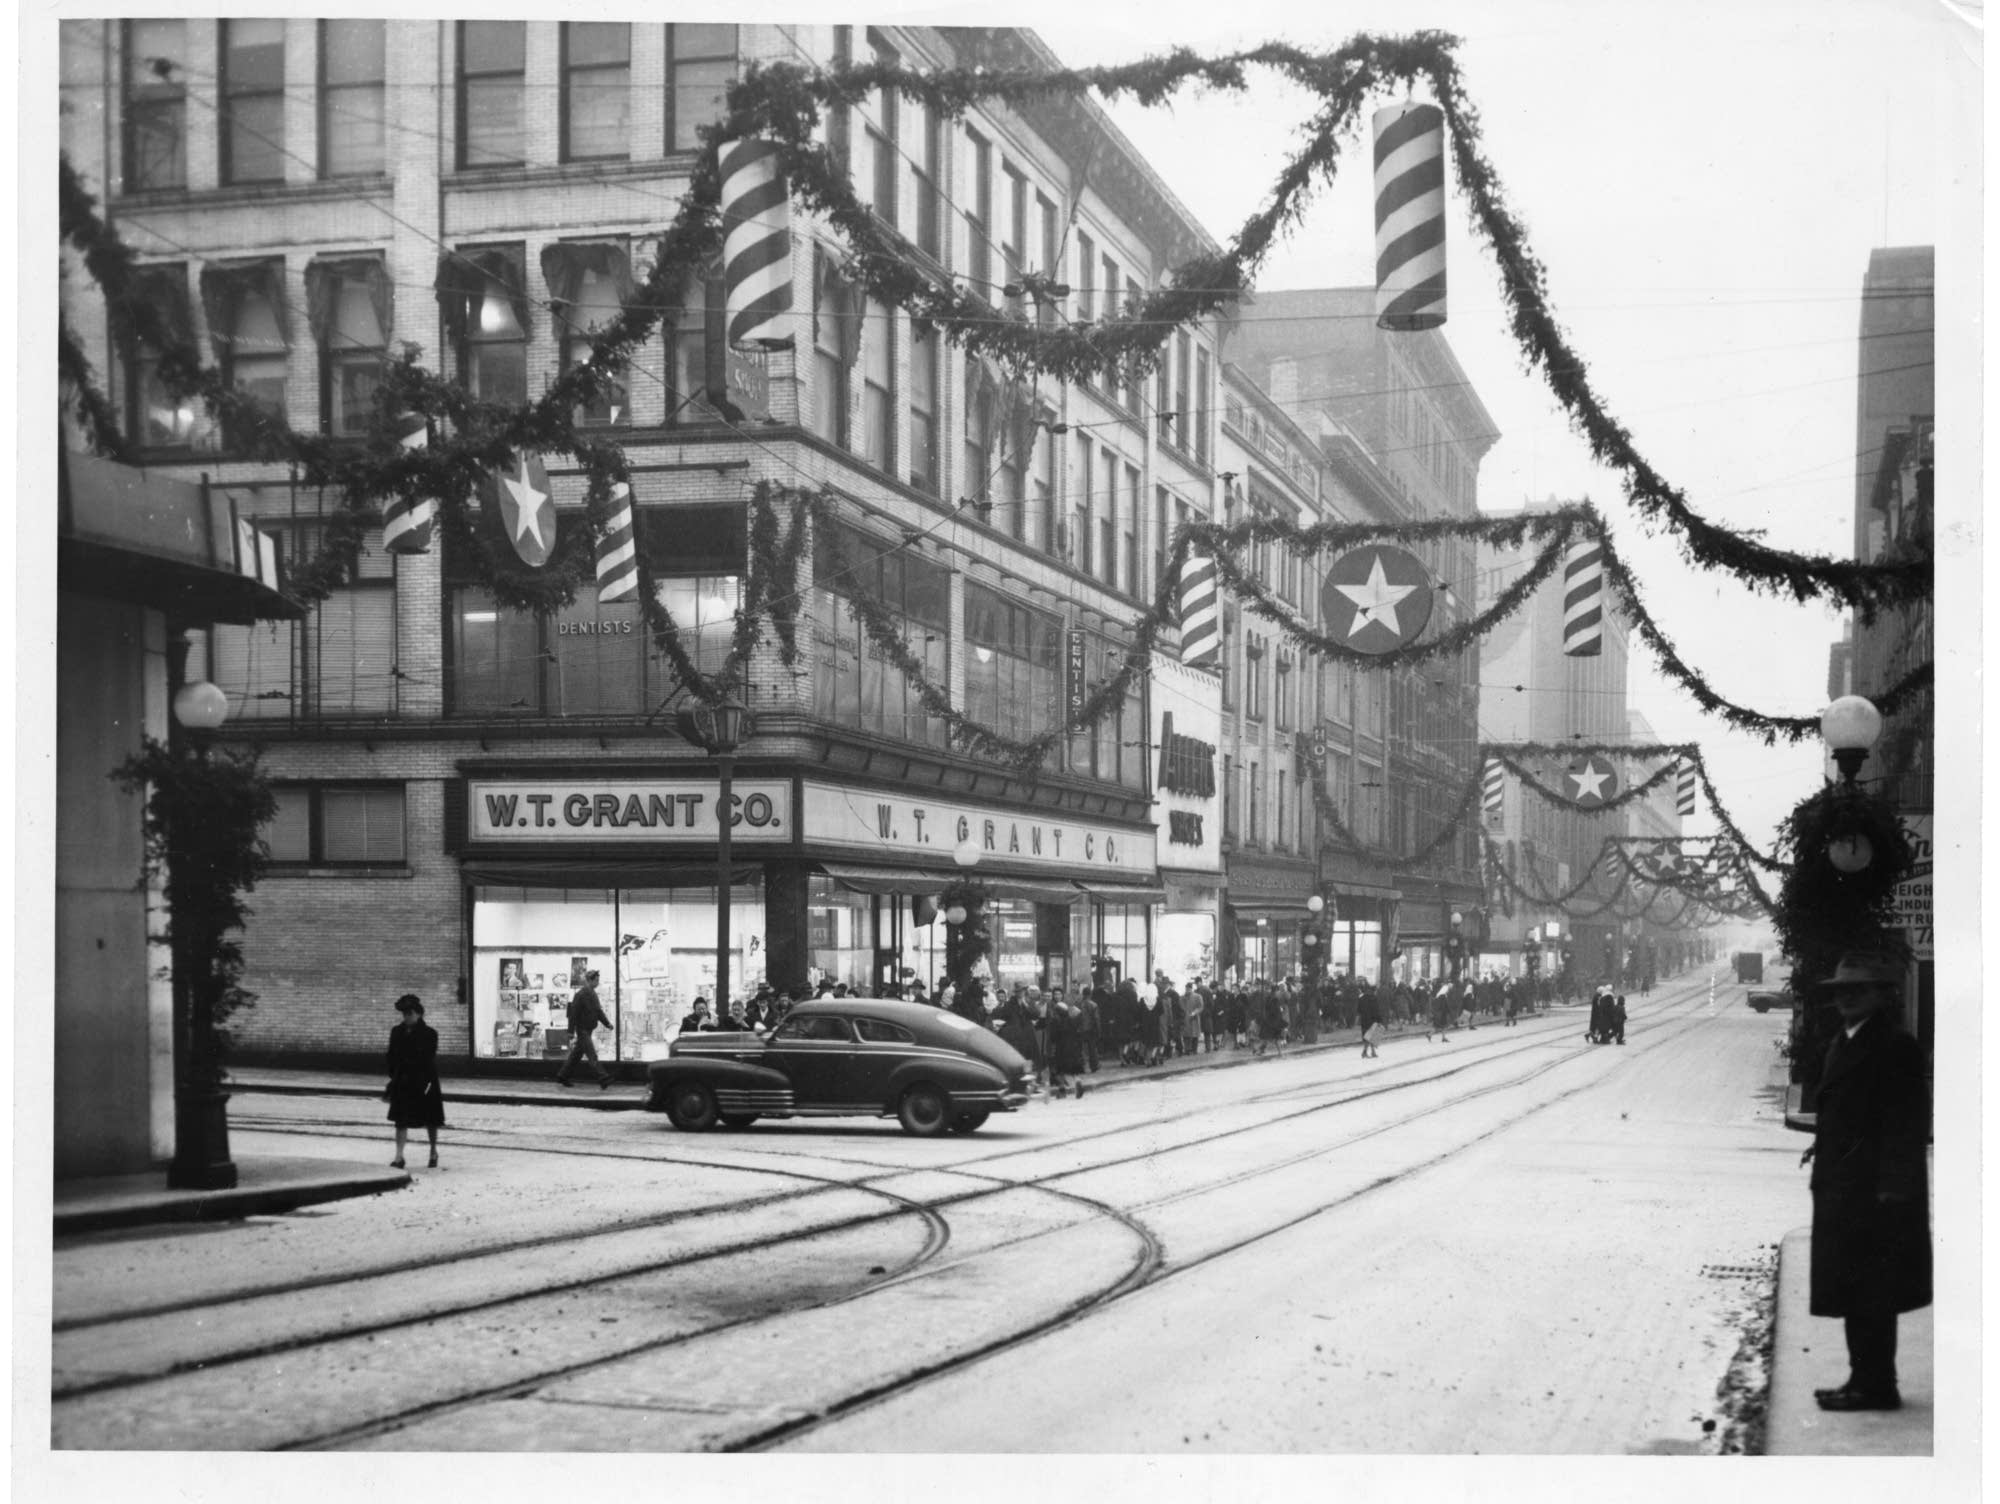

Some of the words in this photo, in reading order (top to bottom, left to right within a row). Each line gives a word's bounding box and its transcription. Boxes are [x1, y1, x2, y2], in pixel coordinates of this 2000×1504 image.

[559, 620, 632, 635] DENTISTS
[563, 793, 703, 828] GRANT
[716, 792, 781, 828] CO.
[956, 815, 1063, 857] GRANT
[1085, 832, 1119, 863] CO.
